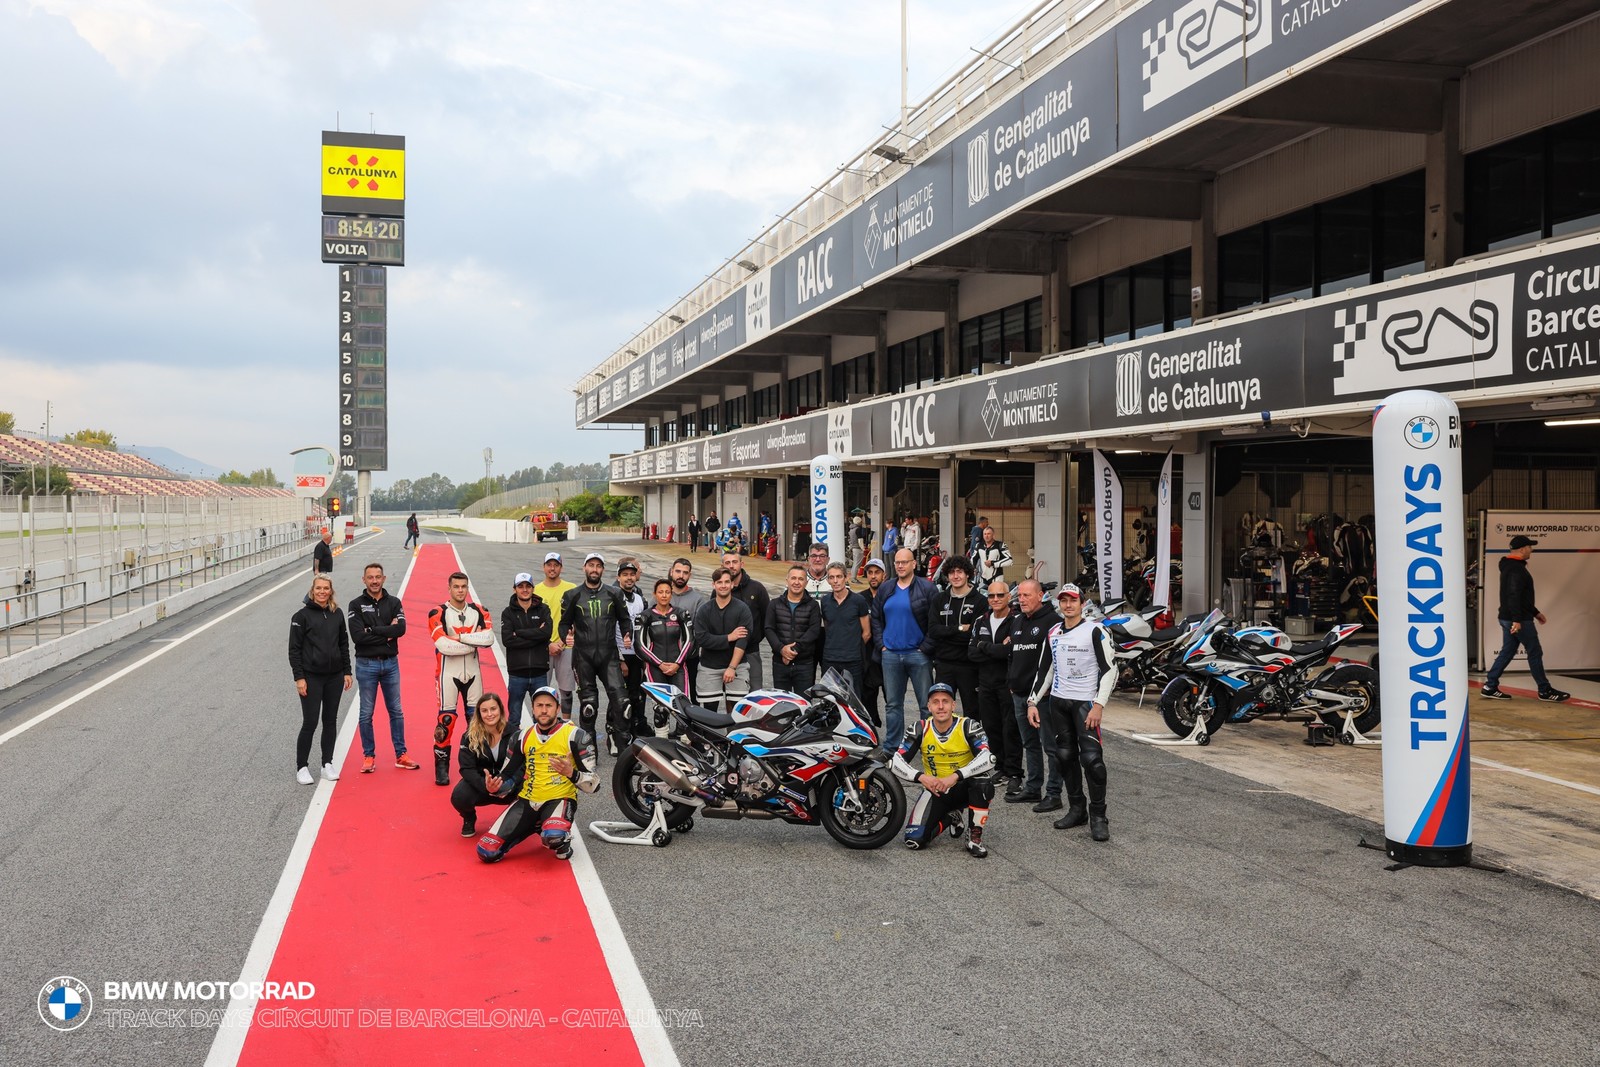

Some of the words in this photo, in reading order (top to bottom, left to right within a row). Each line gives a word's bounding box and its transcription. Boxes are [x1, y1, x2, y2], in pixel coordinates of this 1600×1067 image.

[993, 80, 1073, 155] Generalitat
[993, 161, 1011, 192] de
[1015, 116, 1090, 180] Catalunya
[328, 166, 397, 179] CATALUNYA
[882, 187, 923, 227] AJUNTAMENT
[923, 182, 934, 202] DE
[338, 219, 399, 239] 8:54:20
[882, 205, 934, 251] MONTMELÓ
[325, 243, 367, 256] VOLTA
[343, 271, 350, 282] 1
[797, 236, 834, 305] RACC
[342, 291, 351, 302] 2
[342, 312, 351, 323] 3
[342, 332, 352, 344] 4
[342, 352, 352, 364] 5
[1147, 337, 1242, 379] Generalitat
[1526, 338, 1600, 372] CATAL
[342, 373, 352, 384] 6
[342, 394, 352, 405] 7
[1002, 384, 1045, 404] AJUNTAMENT
[1046, 382, 1058, 399] DE
[1147, 387, 1168, 413] de
[1172, 376, 1261, 410] Catalunya
[342, 414, 352, 426] 8
[890, 393, 936, 449] RACC
[1002, 402, 1058, 427] MONTMELÓ
[342, 434, 352, 446] 9
[342, 455, 353, 466] 10
[736, 440, 760, 464] esportcat
[1190, 494, 1200, 507] 40
[1403, 463, 1447, 750] TRACKDAYS
